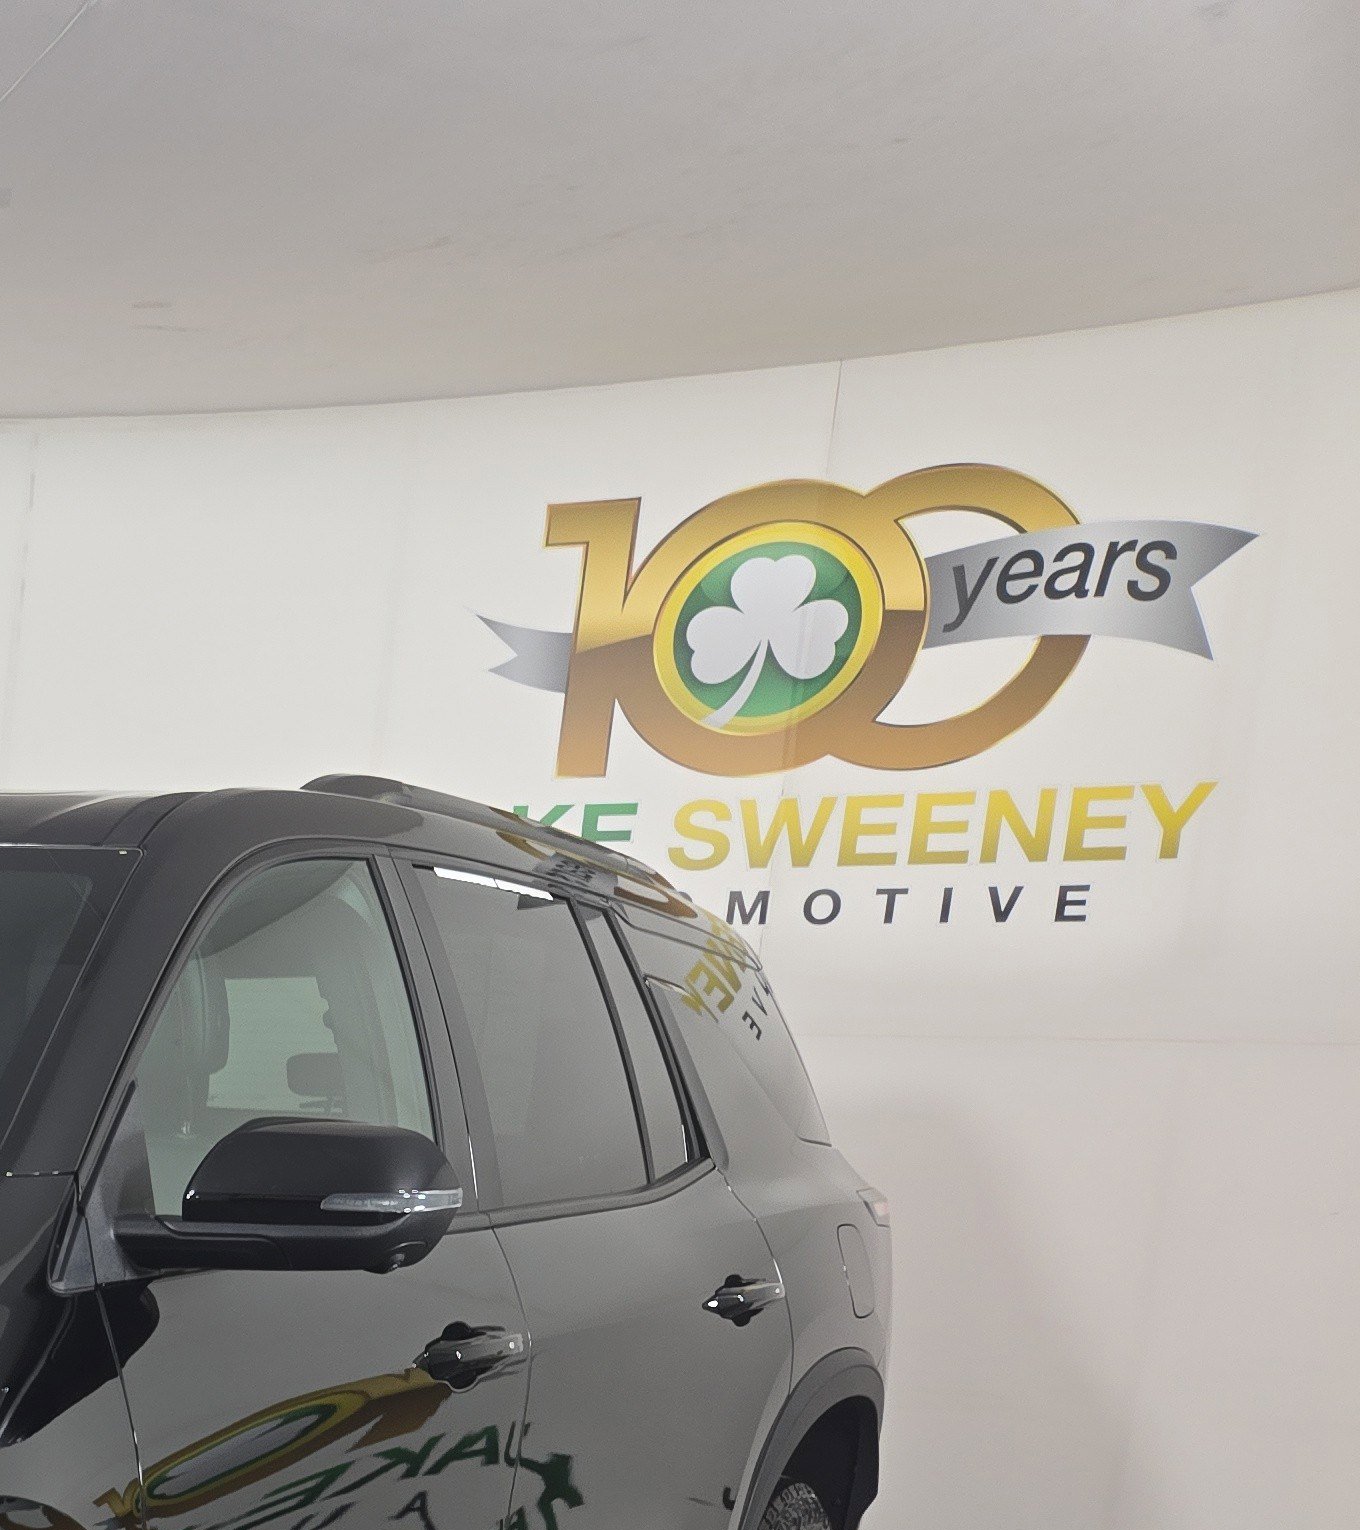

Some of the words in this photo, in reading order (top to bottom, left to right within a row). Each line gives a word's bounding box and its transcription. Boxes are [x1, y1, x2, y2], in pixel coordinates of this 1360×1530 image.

[544, 462, 1092, 780] 100
[941, 534, 1178, 633] years
[666, 781, 1219, 872] SWEENEY
[723, 883, 1093, 927] MOTIVE
